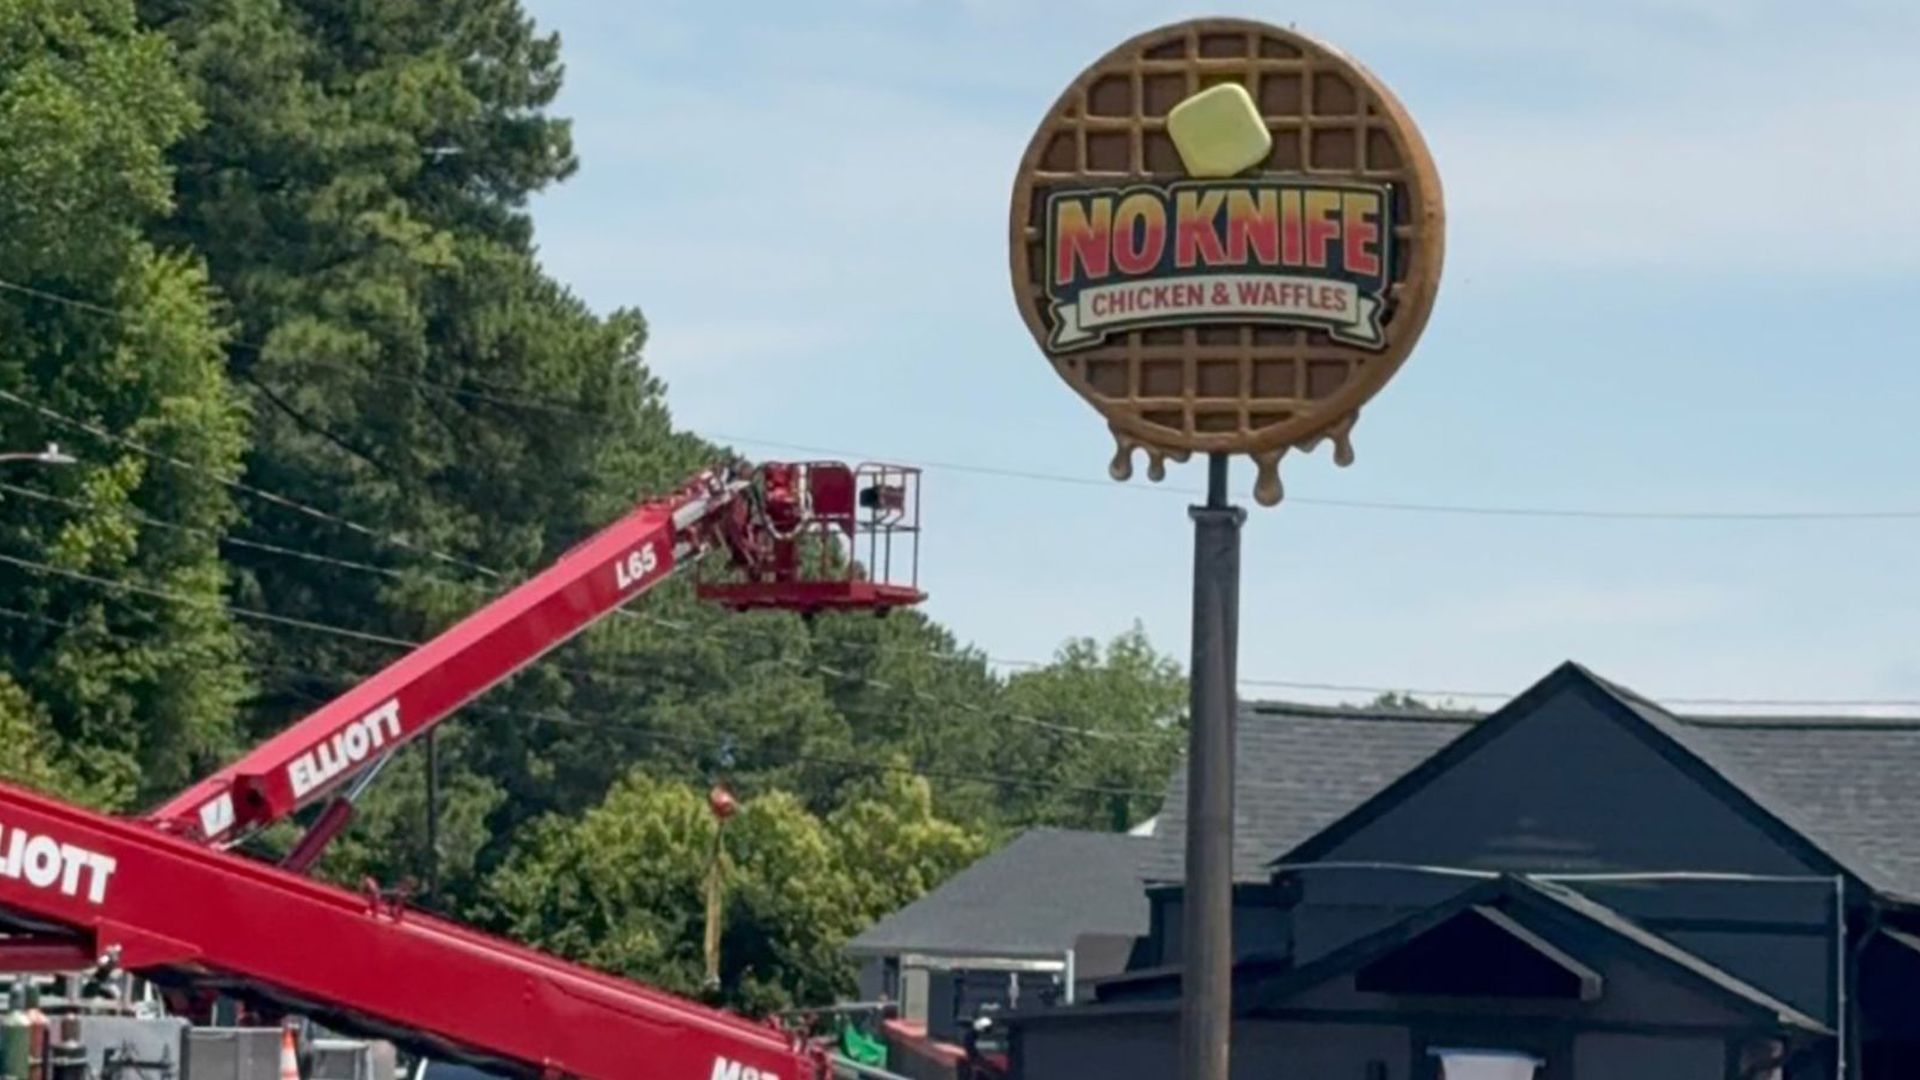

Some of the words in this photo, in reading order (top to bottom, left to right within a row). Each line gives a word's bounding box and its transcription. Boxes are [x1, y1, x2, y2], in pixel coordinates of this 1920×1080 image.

[1056, 193, 1167, 286] NO
[1174, 188, 1380, 277] KNIFE
[1091, 282, 1204, 317] CHICKEN
[1210, 281, 1230, 306] &
[1236, 282, 1348, 313] WAFFLES
[615, 541, 657, 590] L65
[287, 697, 401, 799] ELLIOTT
[0, 822, 117, 904] IOTT
